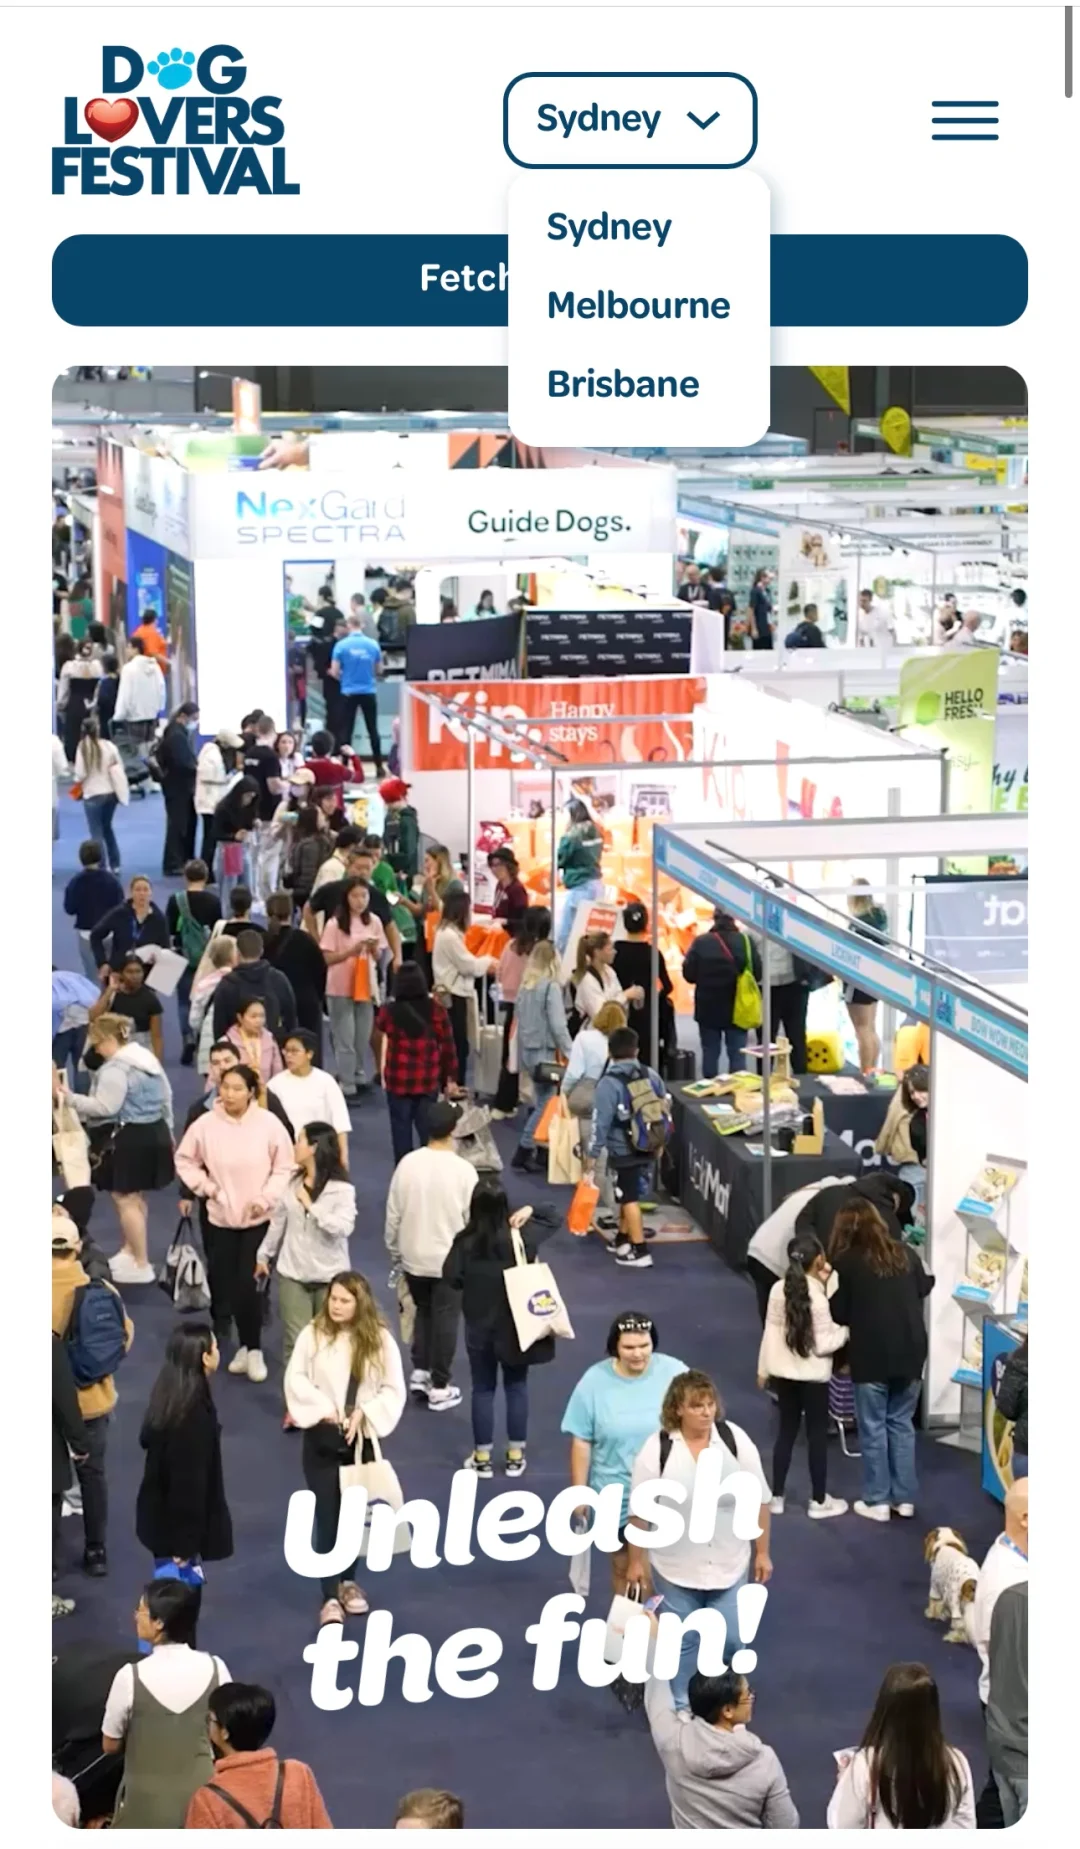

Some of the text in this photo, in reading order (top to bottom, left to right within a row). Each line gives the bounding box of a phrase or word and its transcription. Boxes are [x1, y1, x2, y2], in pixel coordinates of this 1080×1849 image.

[537, 103, 661, 139] Sydney
[52, 147, 301, 197] FESTIVAL
[547, 211, 672, 248] Sydney
[548, 290, 731, 319] Melbourne
[548, 368, 700, 398] Brisbane
[236, 490, 405, 521] NexGard
[236, 524, 406, 544] SPECTRA
[468, 509, 632, 541] Guide Dogs.
[944, 688, 983, 705] HELLO
[549, 725, 599, 747] stays
